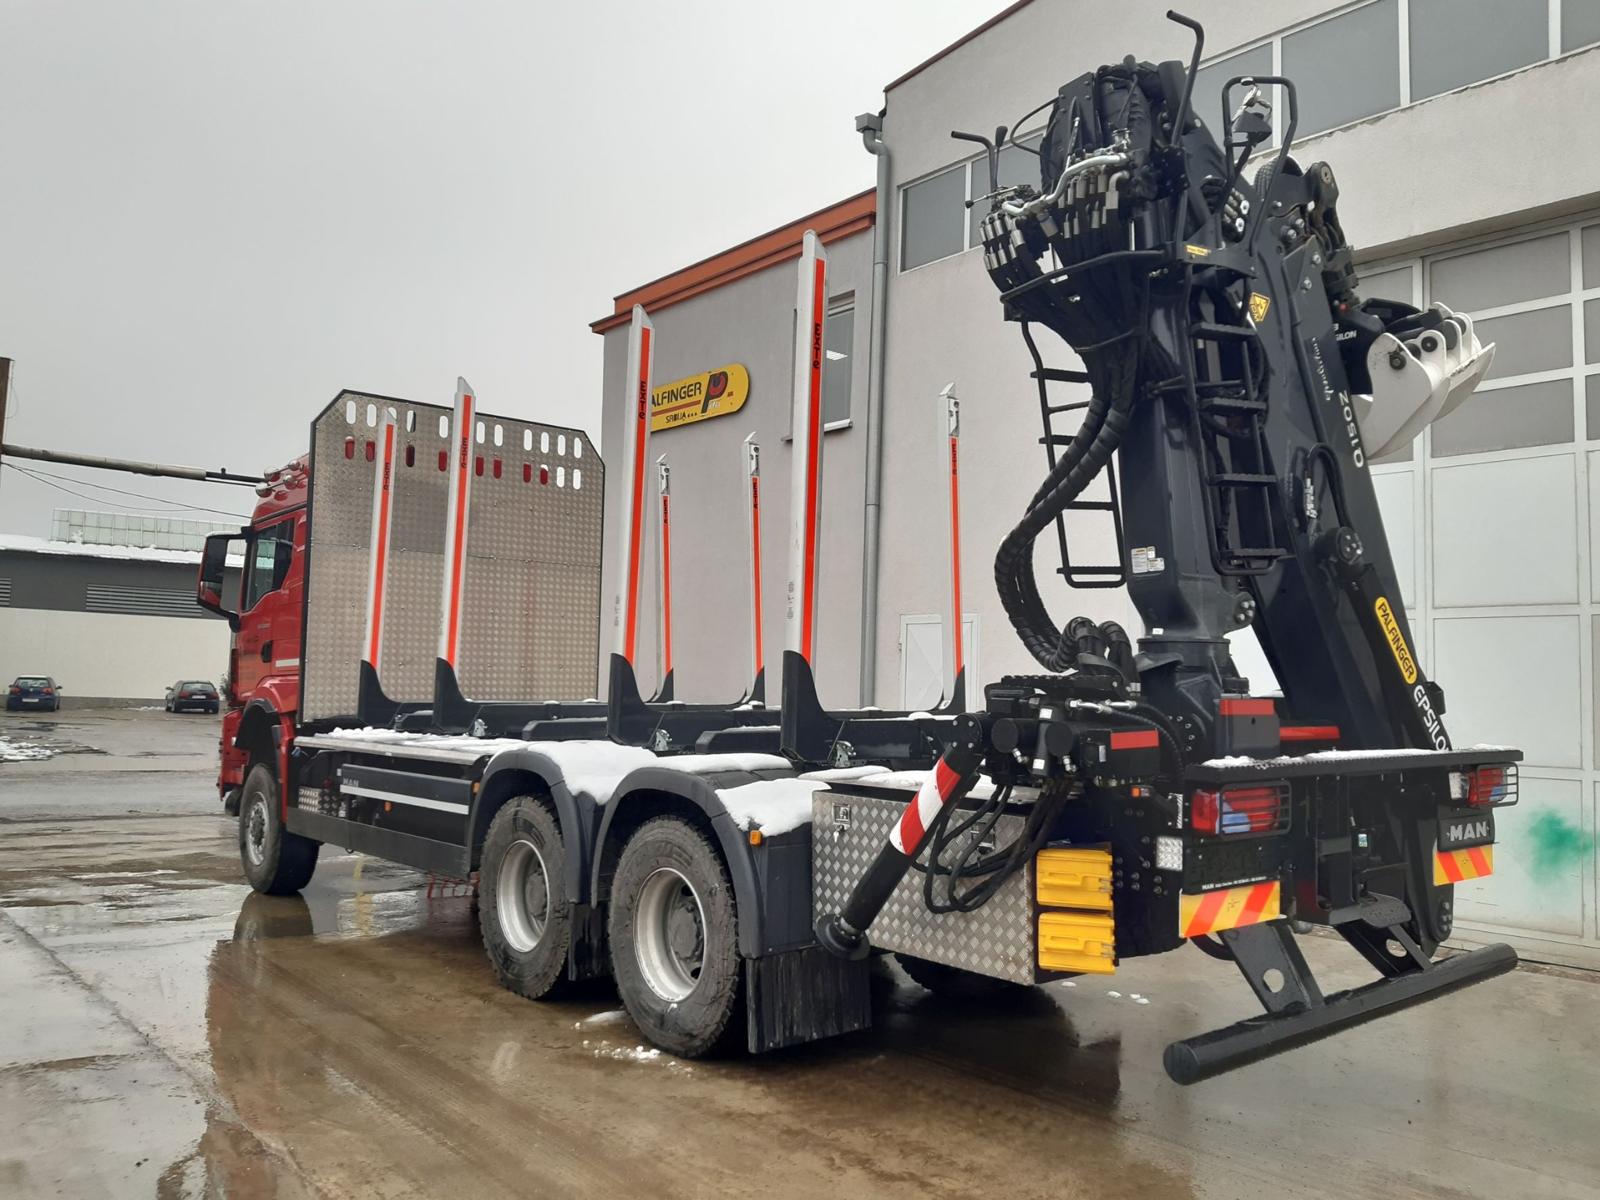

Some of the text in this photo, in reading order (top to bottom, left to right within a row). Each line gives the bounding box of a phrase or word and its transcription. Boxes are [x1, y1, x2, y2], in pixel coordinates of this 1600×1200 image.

[1335, 330, 1357, 341] SILON
[652, 381, 702, 407] ALFINGER
[1378, 602, 1415, 679] PALFINGER
[1413, 685, 1450, 751] EPSILO
[1450, 821, 1487, 841] MAN
